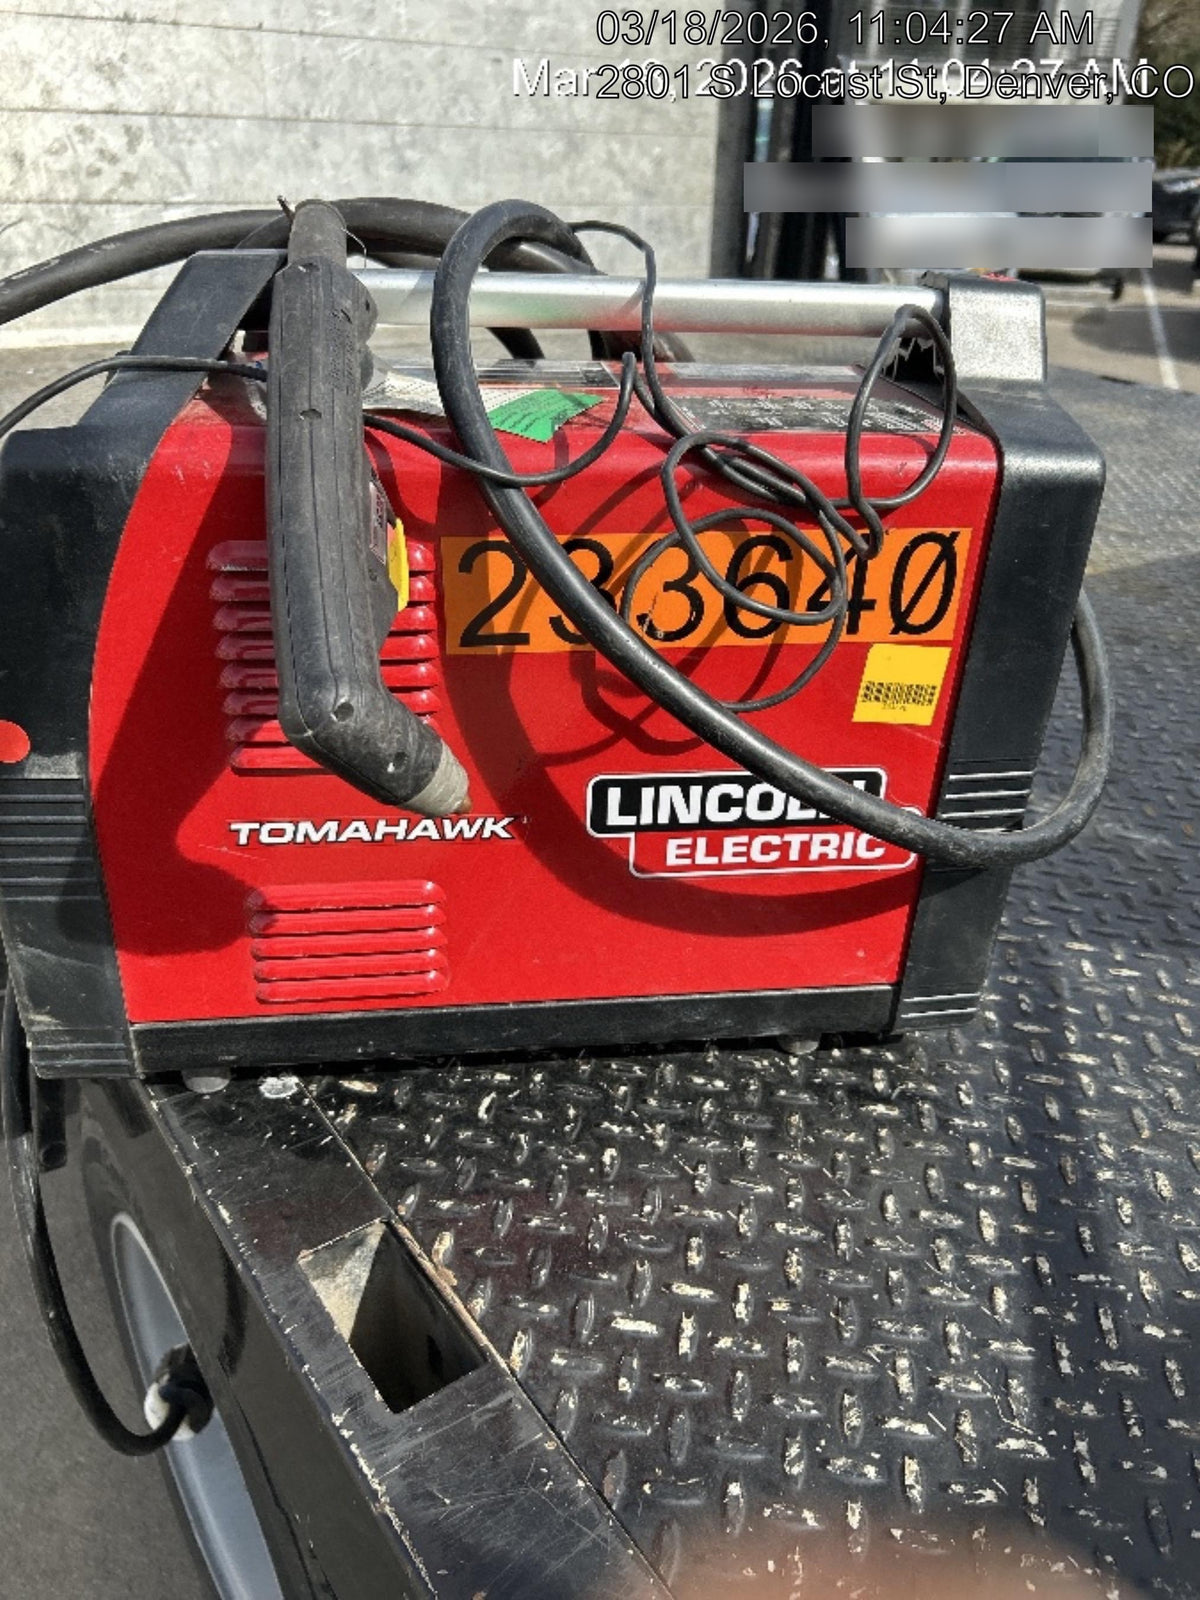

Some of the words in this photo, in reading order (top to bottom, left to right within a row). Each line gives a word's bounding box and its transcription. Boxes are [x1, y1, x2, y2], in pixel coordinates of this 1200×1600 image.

[606, 779, 867, 826] LINCOL
[228, 816, 516, 847] TOMAHAWK
[666, 831, 886, 867] ELECTRIC
